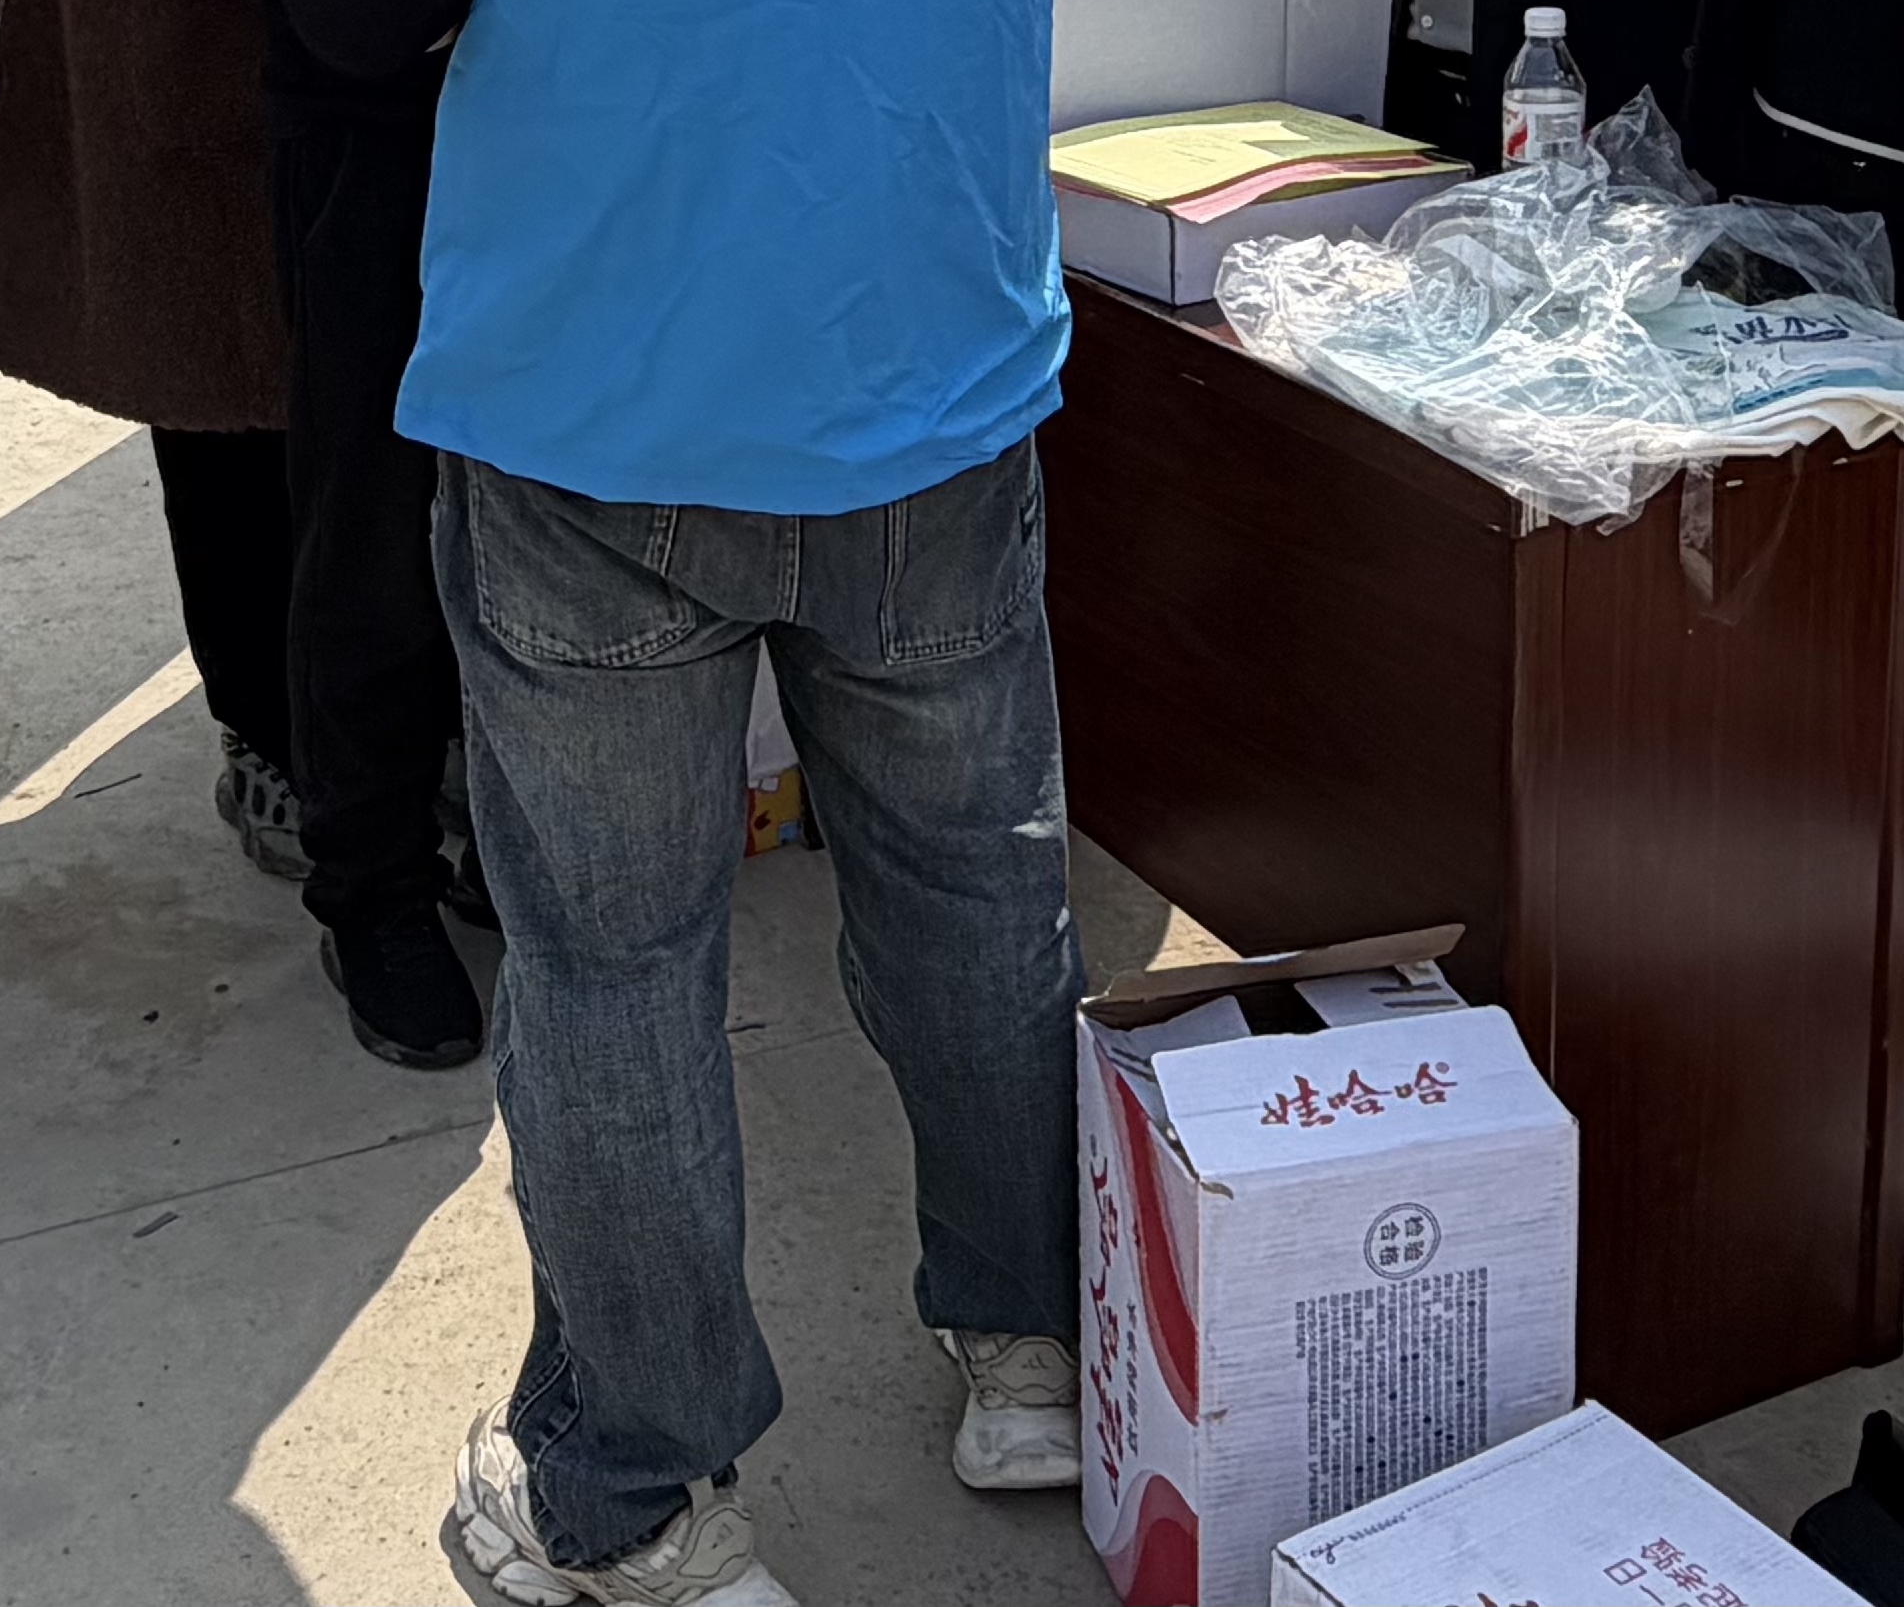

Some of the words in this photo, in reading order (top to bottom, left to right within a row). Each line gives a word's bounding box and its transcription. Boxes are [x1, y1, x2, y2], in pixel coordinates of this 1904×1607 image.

[1260, 1061, 1459, 1128] 娃哈哈
[1088, 1156, 1124, 1508] 娃哈哈
